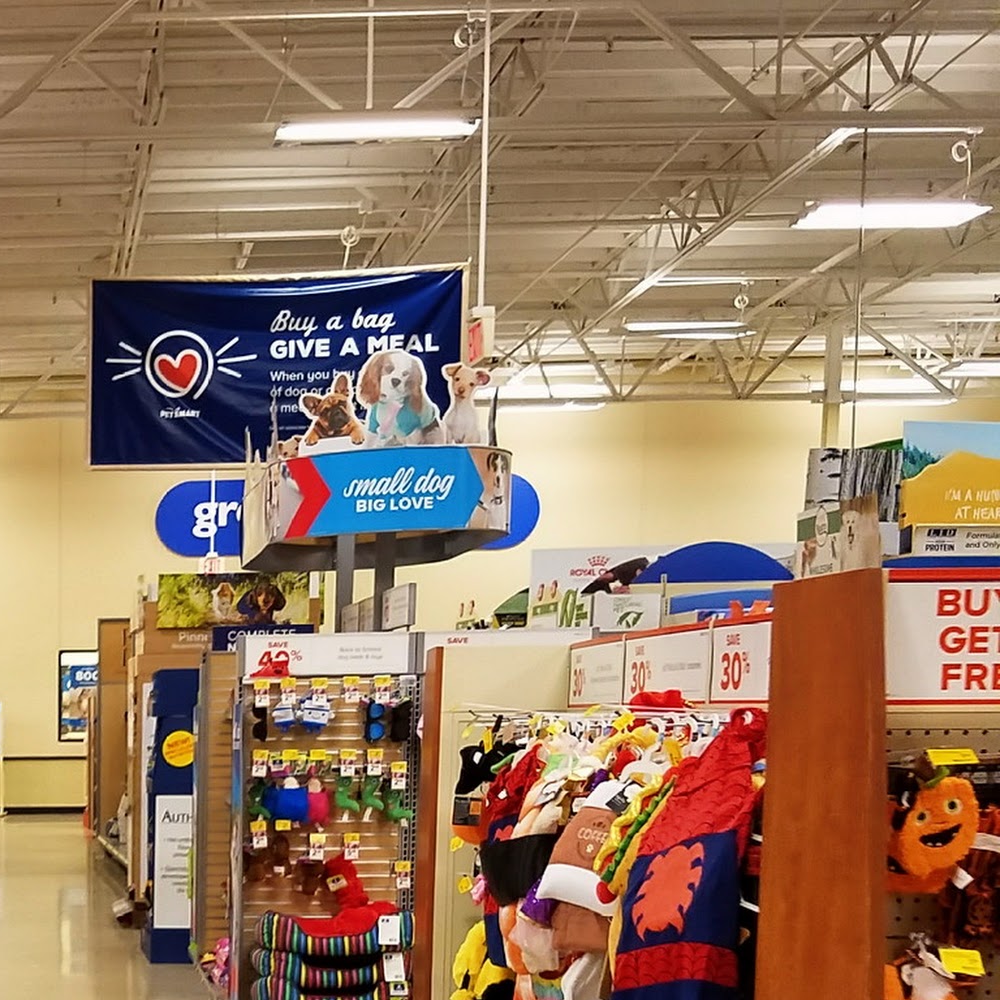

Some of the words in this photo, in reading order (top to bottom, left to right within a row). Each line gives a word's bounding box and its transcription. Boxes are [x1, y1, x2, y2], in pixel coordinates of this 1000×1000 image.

[270, 309, 318, 337] Buy
[326, 315, 343, 330] a
[351, 307, 396, 333] bag
[270, 338, 331, 359] GIVE
[339, 337, 360, 356] A
[367, 333, 440, 354] MEAL
[270, 370, 304, 382] When
[307, 371, 330, 383] you
[270, 386, 283, 397] of
[284, 385, 308, 397] dog
[343, 467, 415, 498] small
[414, 468, 455, 500] dog
[964, 489, 972, 501] A
[356, 498, 386, 512] BIG
[389, 496, 434, 511] LOVE
[955, 505, 972, 519] AT
[925, 544, 955, 552] PROTEIN
[570, 568, 596, 576] ROYAL
[727, 634, 740, 646] SAVE
[720, 651, 749, 690] 30%
